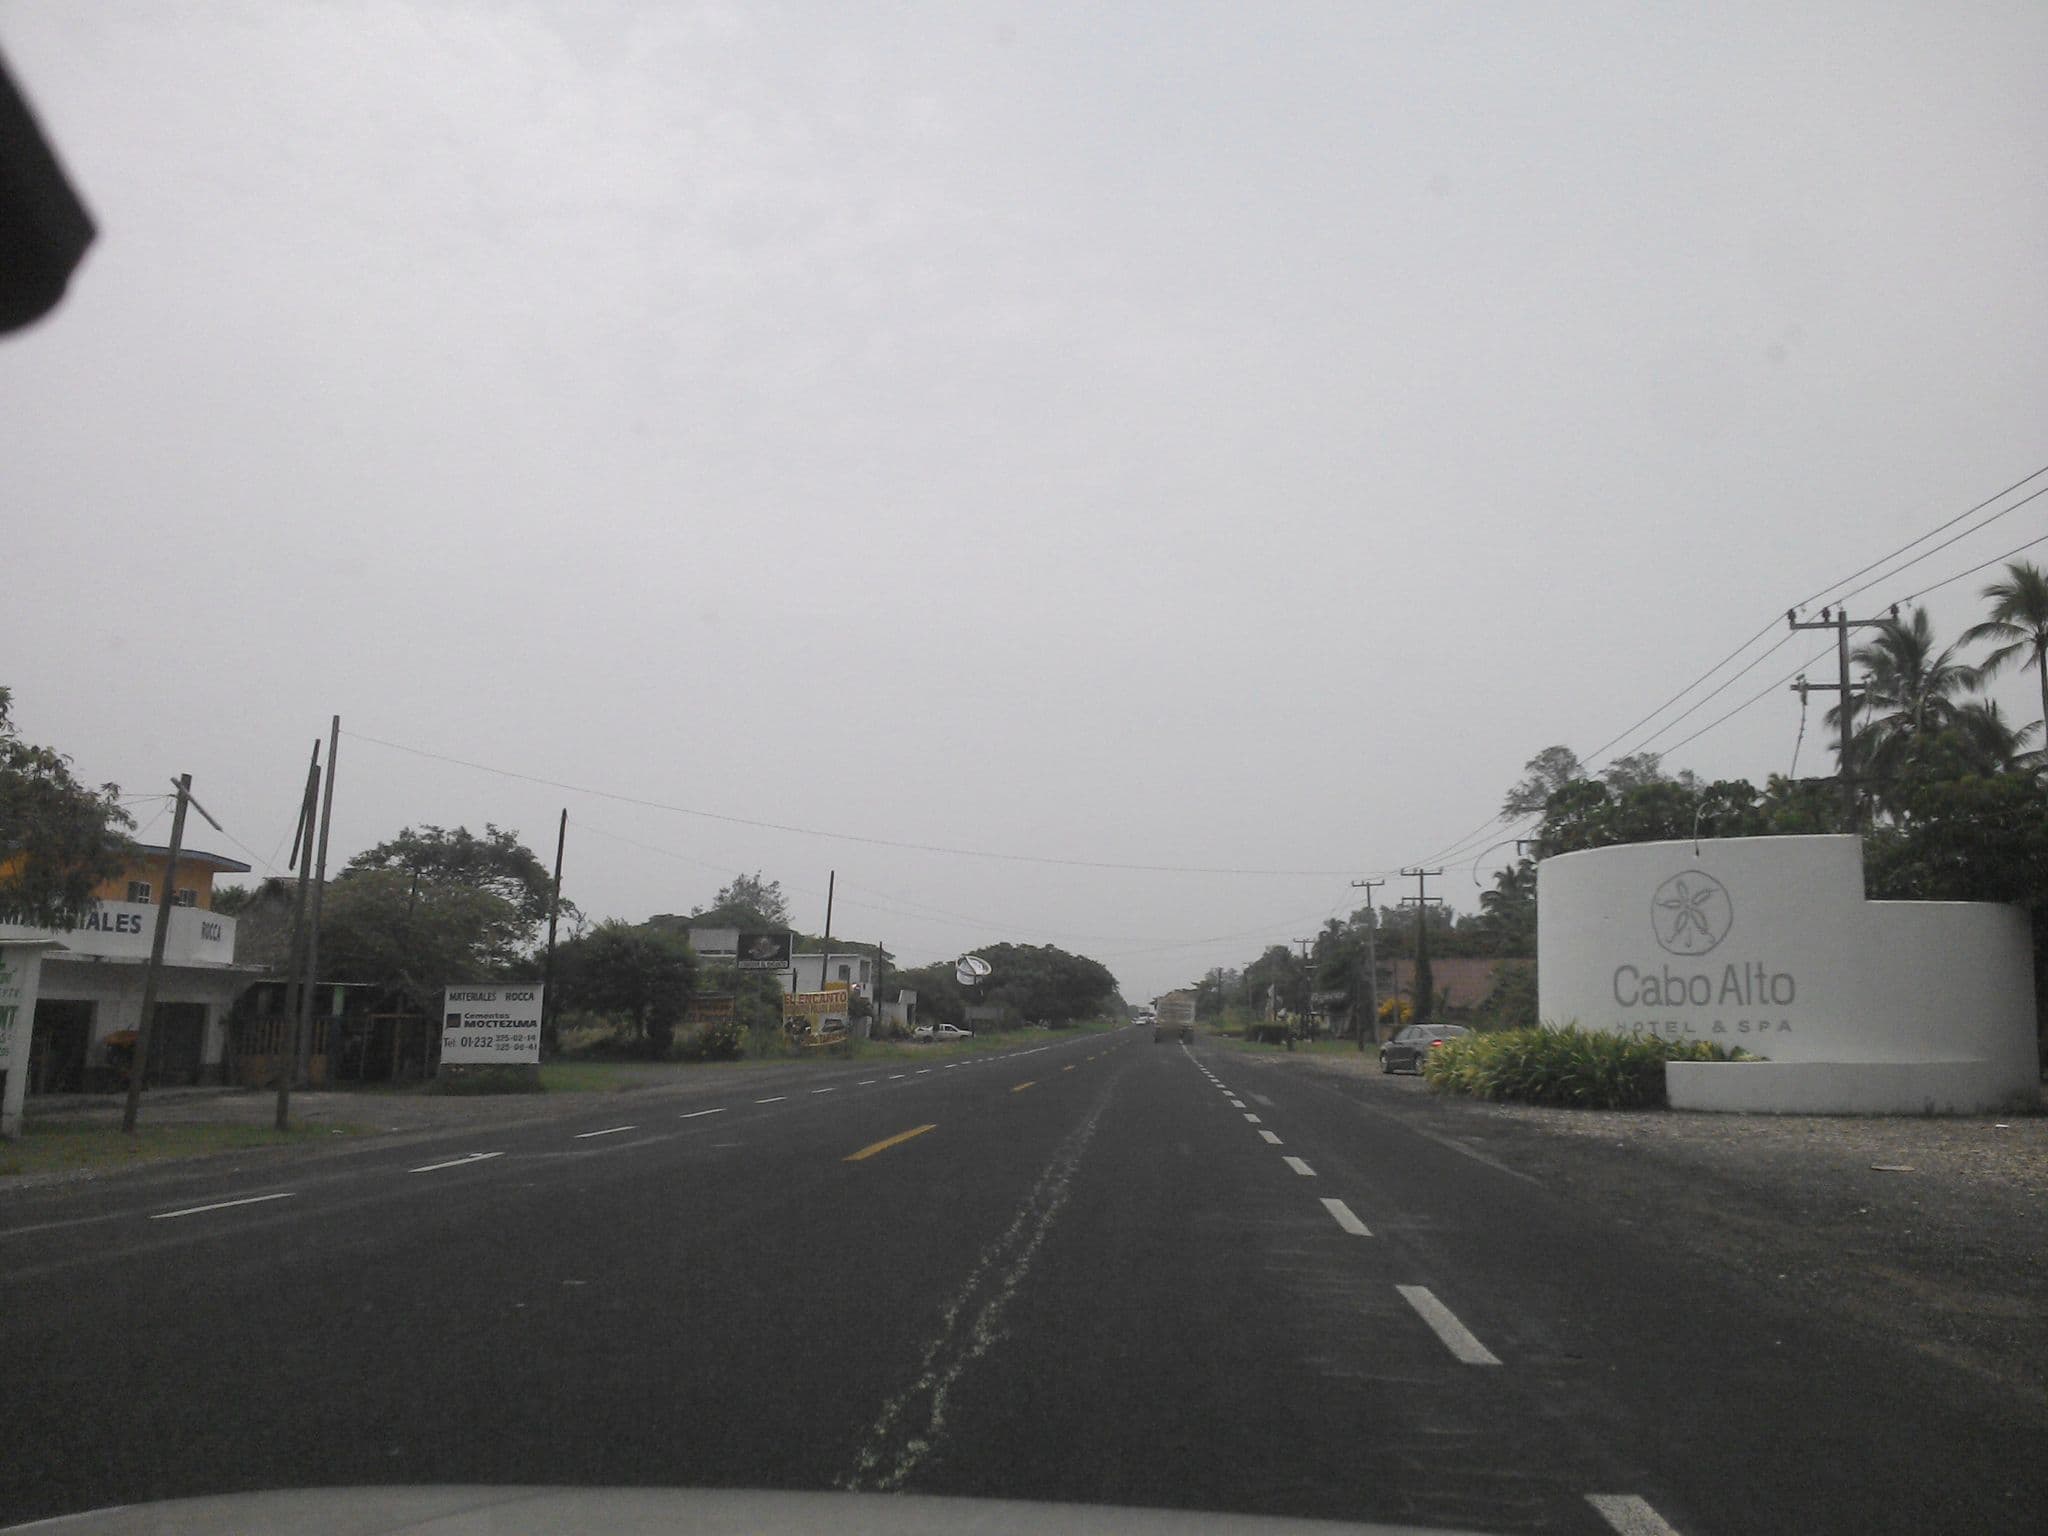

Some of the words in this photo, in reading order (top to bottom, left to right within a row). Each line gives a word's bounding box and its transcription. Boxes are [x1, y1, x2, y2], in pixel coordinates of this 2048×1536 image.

[1612, 963, 1711, 1008] Cabo
[1718, 961, 1796, 1006] Alto
[449, 991, 497, 1002] MATERIALES
[505, 991, 535, 1002] ROCCA
[798, 992, 847, 1005] ENCANTO
[464, 1012, 510, 1020] Cementos
[464, 1020, 538, 1028] MOCTEZUMA
[1615, 1020, 1697, 1034] HOTEL
[1711, 1020, 1728, 1033] &
[1738, 1019, 1793, 1033] SPA
